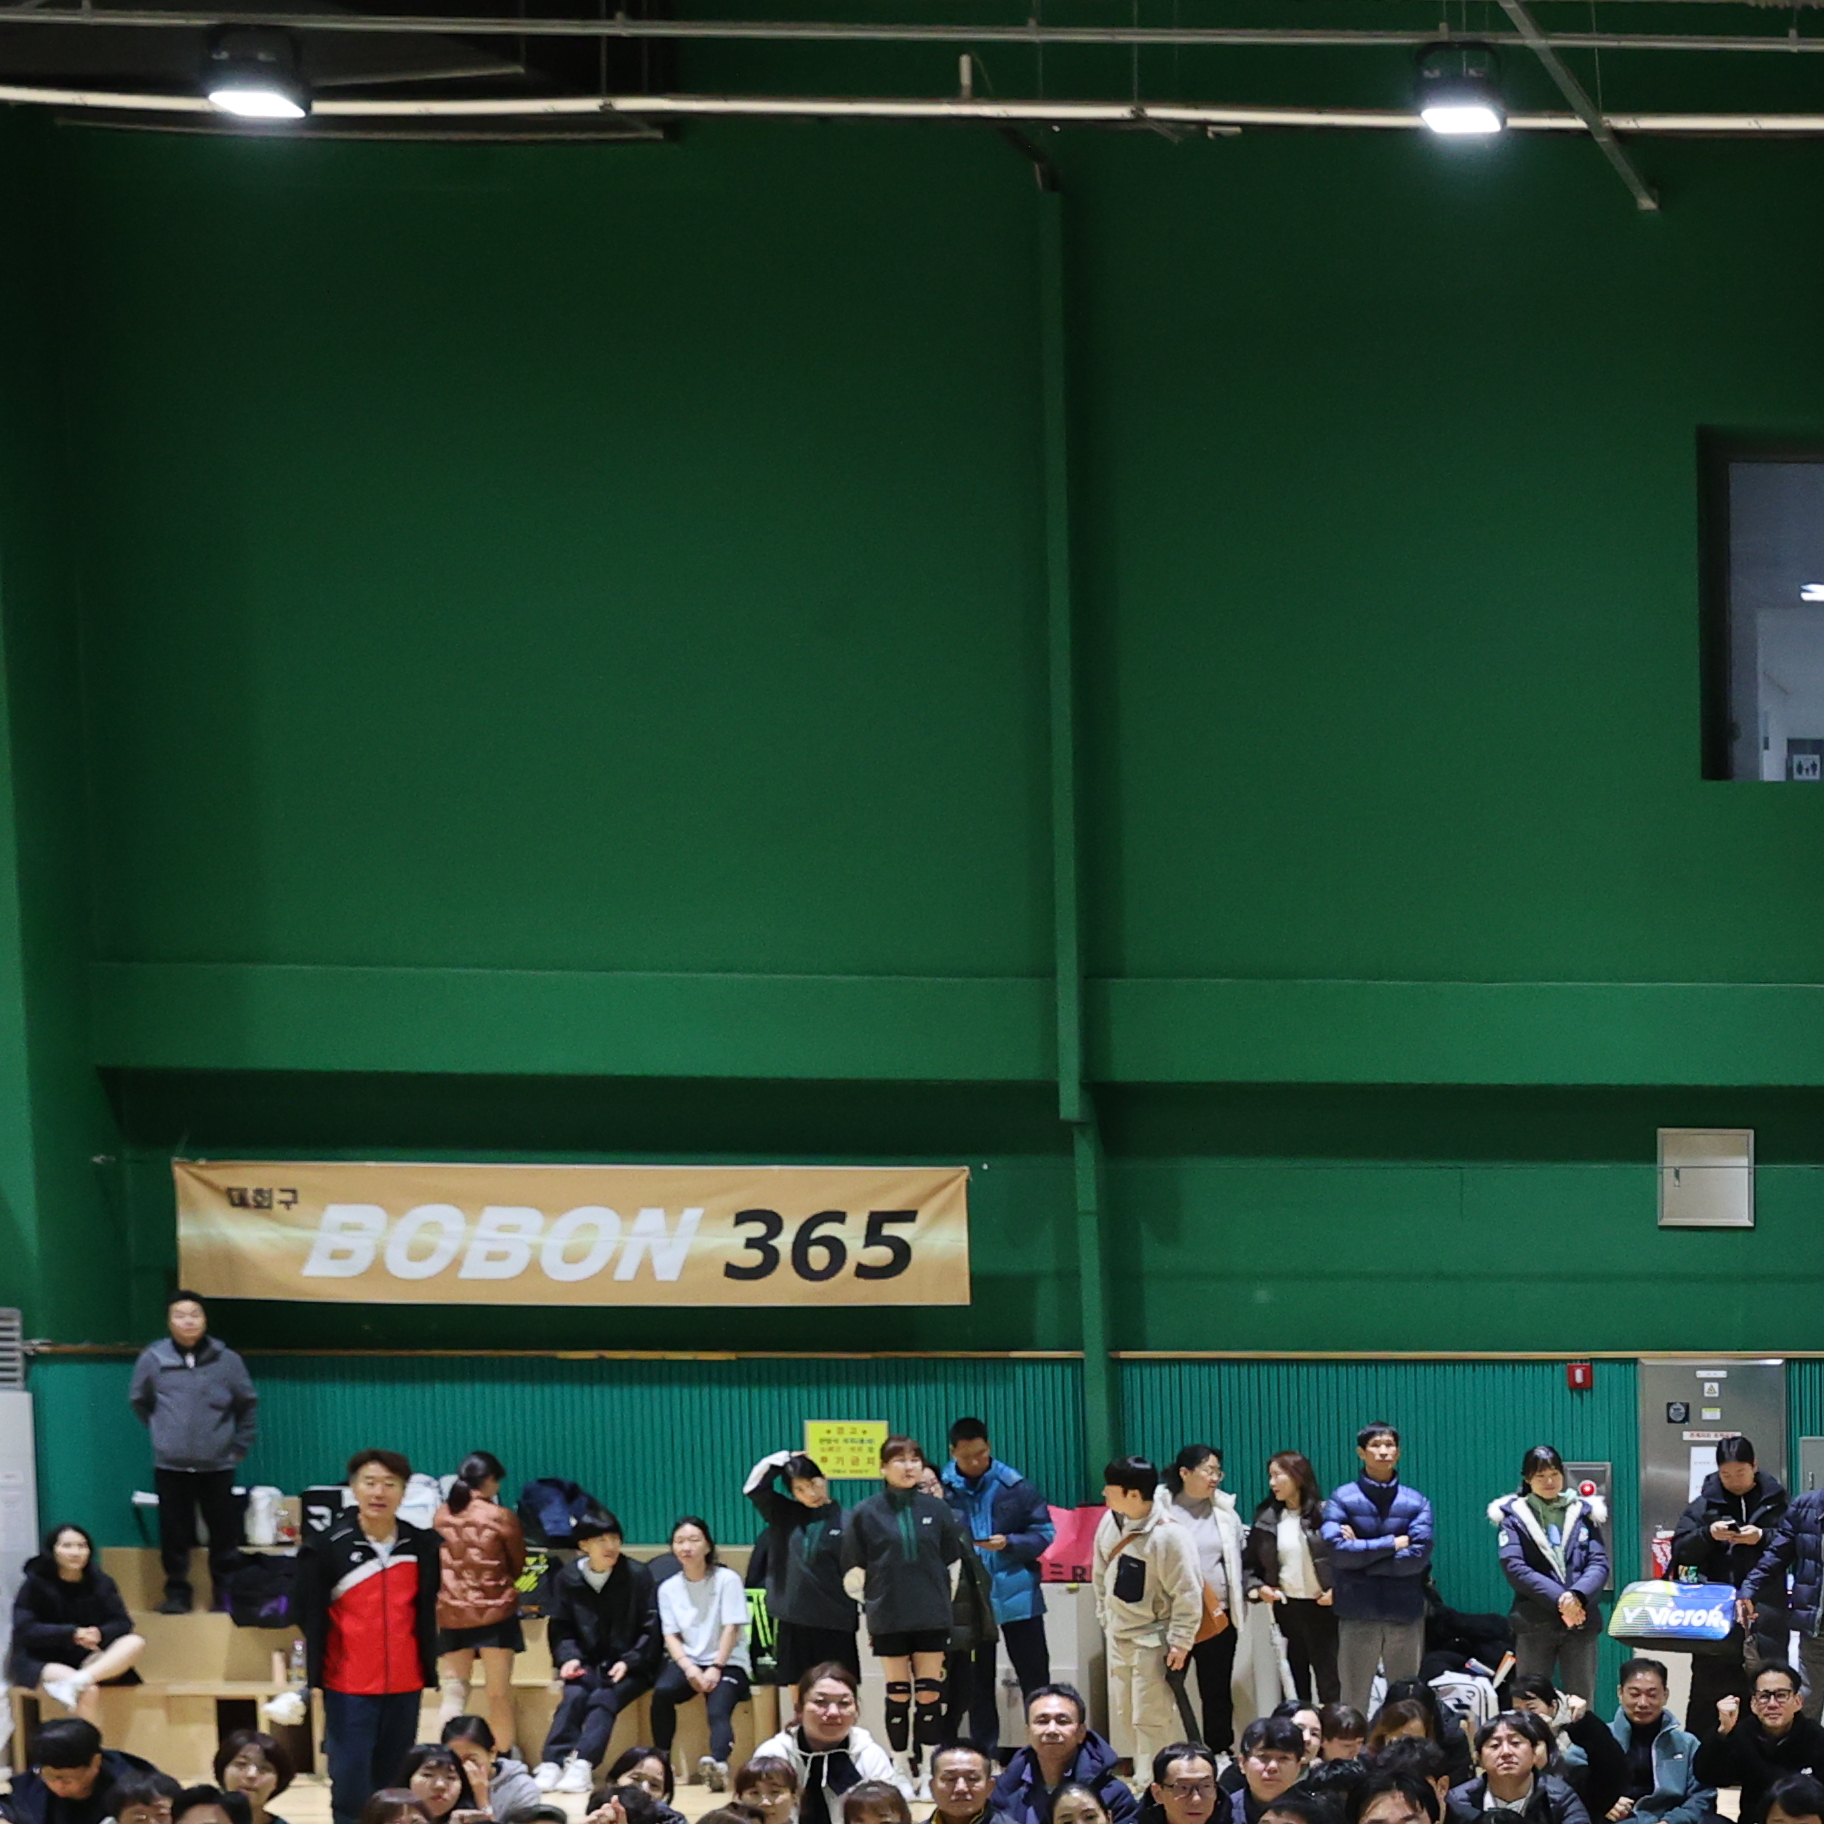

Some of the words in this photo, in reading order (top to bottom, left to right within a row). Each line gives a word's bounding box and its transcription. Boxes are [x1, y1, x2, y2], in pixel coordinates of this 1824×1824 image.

[301, 1203, 705, 1282] BOBON
[723, 1208, 919, 1282] 365
[1646, 1606, 1727, 1628] VICTOR
